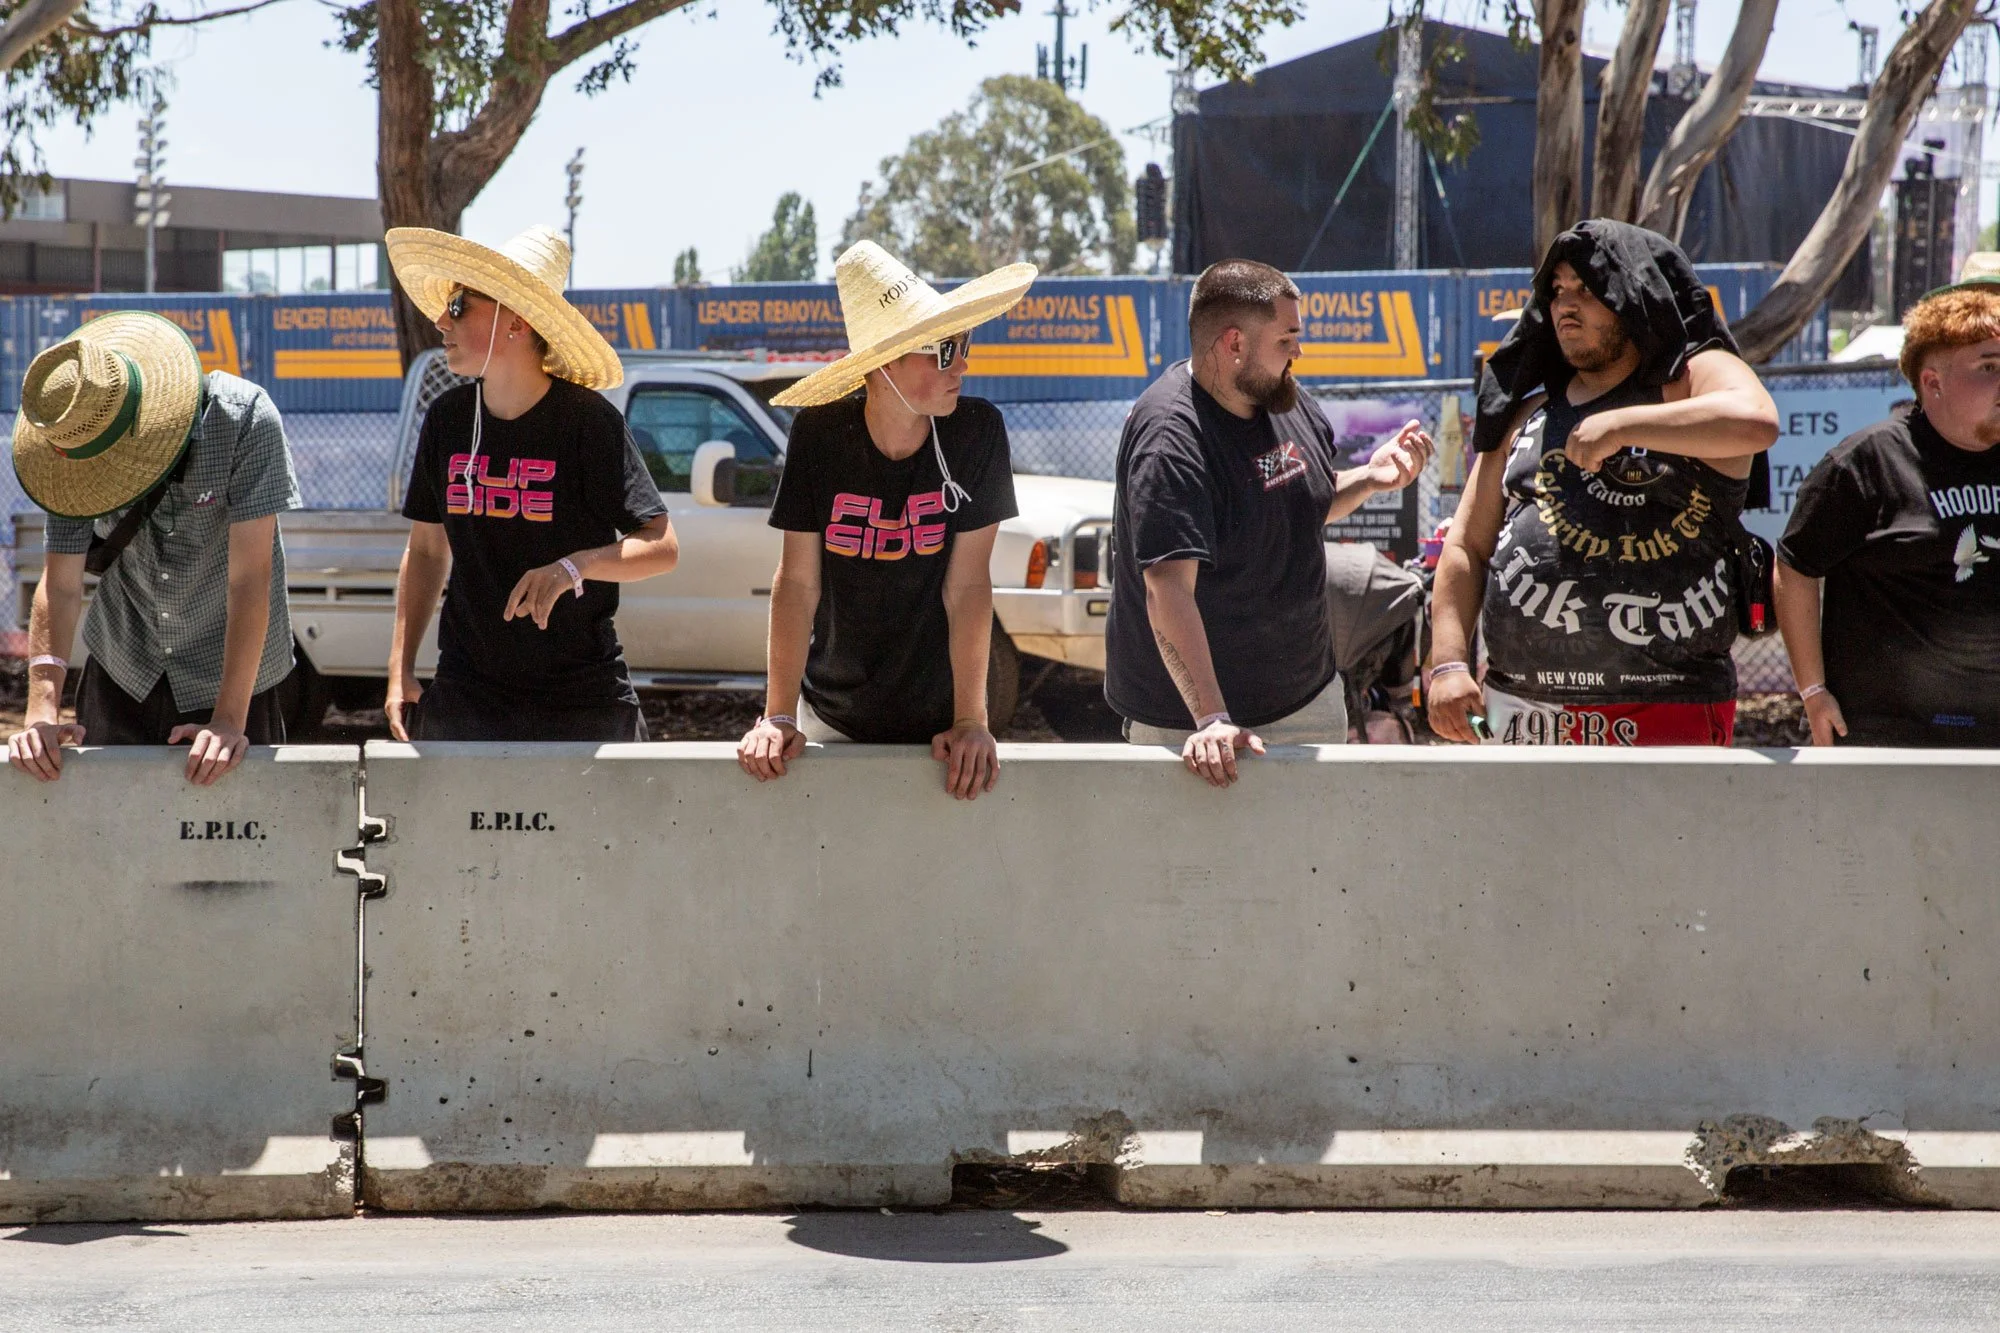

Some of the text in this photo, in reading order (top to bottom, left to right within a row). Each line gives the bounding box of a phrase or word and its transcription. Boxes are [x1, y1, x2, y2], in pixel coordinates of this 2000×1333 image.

[273, 307, 396, 330] LEADER REMOVAL
[698, 301, 761, 324] LEADER
[1039, 324, 1100, 345] storage
[1309, 320, 1373, 340] storage
[448, 453, 556, 489] FLIP
[447, 484, 553, 522] SIDE
[825, 523, 946, 561] SIDE
[1618, 528, 1680, 562] Ink
[1495, 546, 1587, 635] Ink
[1537, 671, 1565, 685] NEW
[1568, 671, 1605, 686] YORK
[1503, 711, 1638, 745] 49ERS
[180, 821, 267, 840] E.P.I.C.
[469, 811, 556, 831] E.P.I.C.
